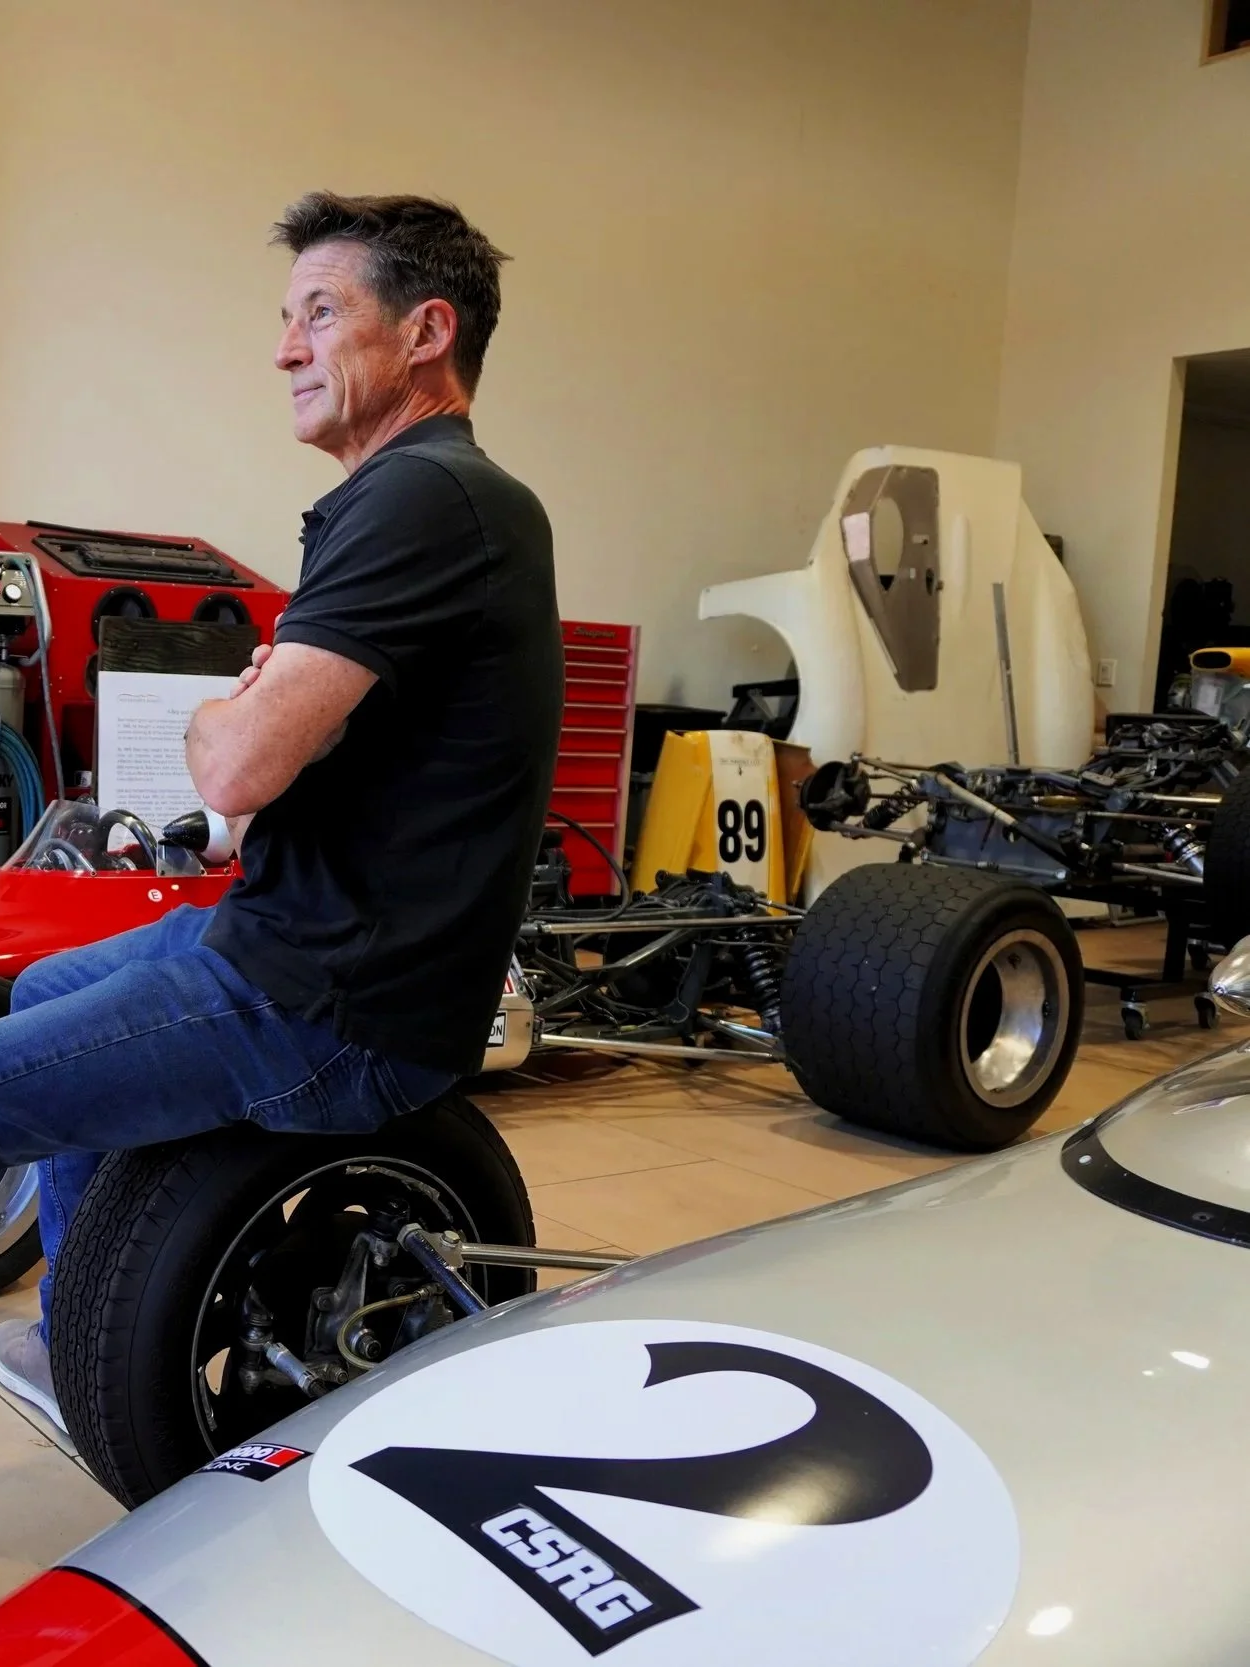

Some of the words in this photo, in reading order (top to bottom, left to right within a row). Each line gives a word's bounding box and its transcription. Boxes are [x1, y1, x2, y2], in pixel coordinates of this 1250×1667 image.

[717, 798, 767, 863] 89
[348, 1340, 935, 1659] 2
[480, 1505, 655, 1632] CSRG
